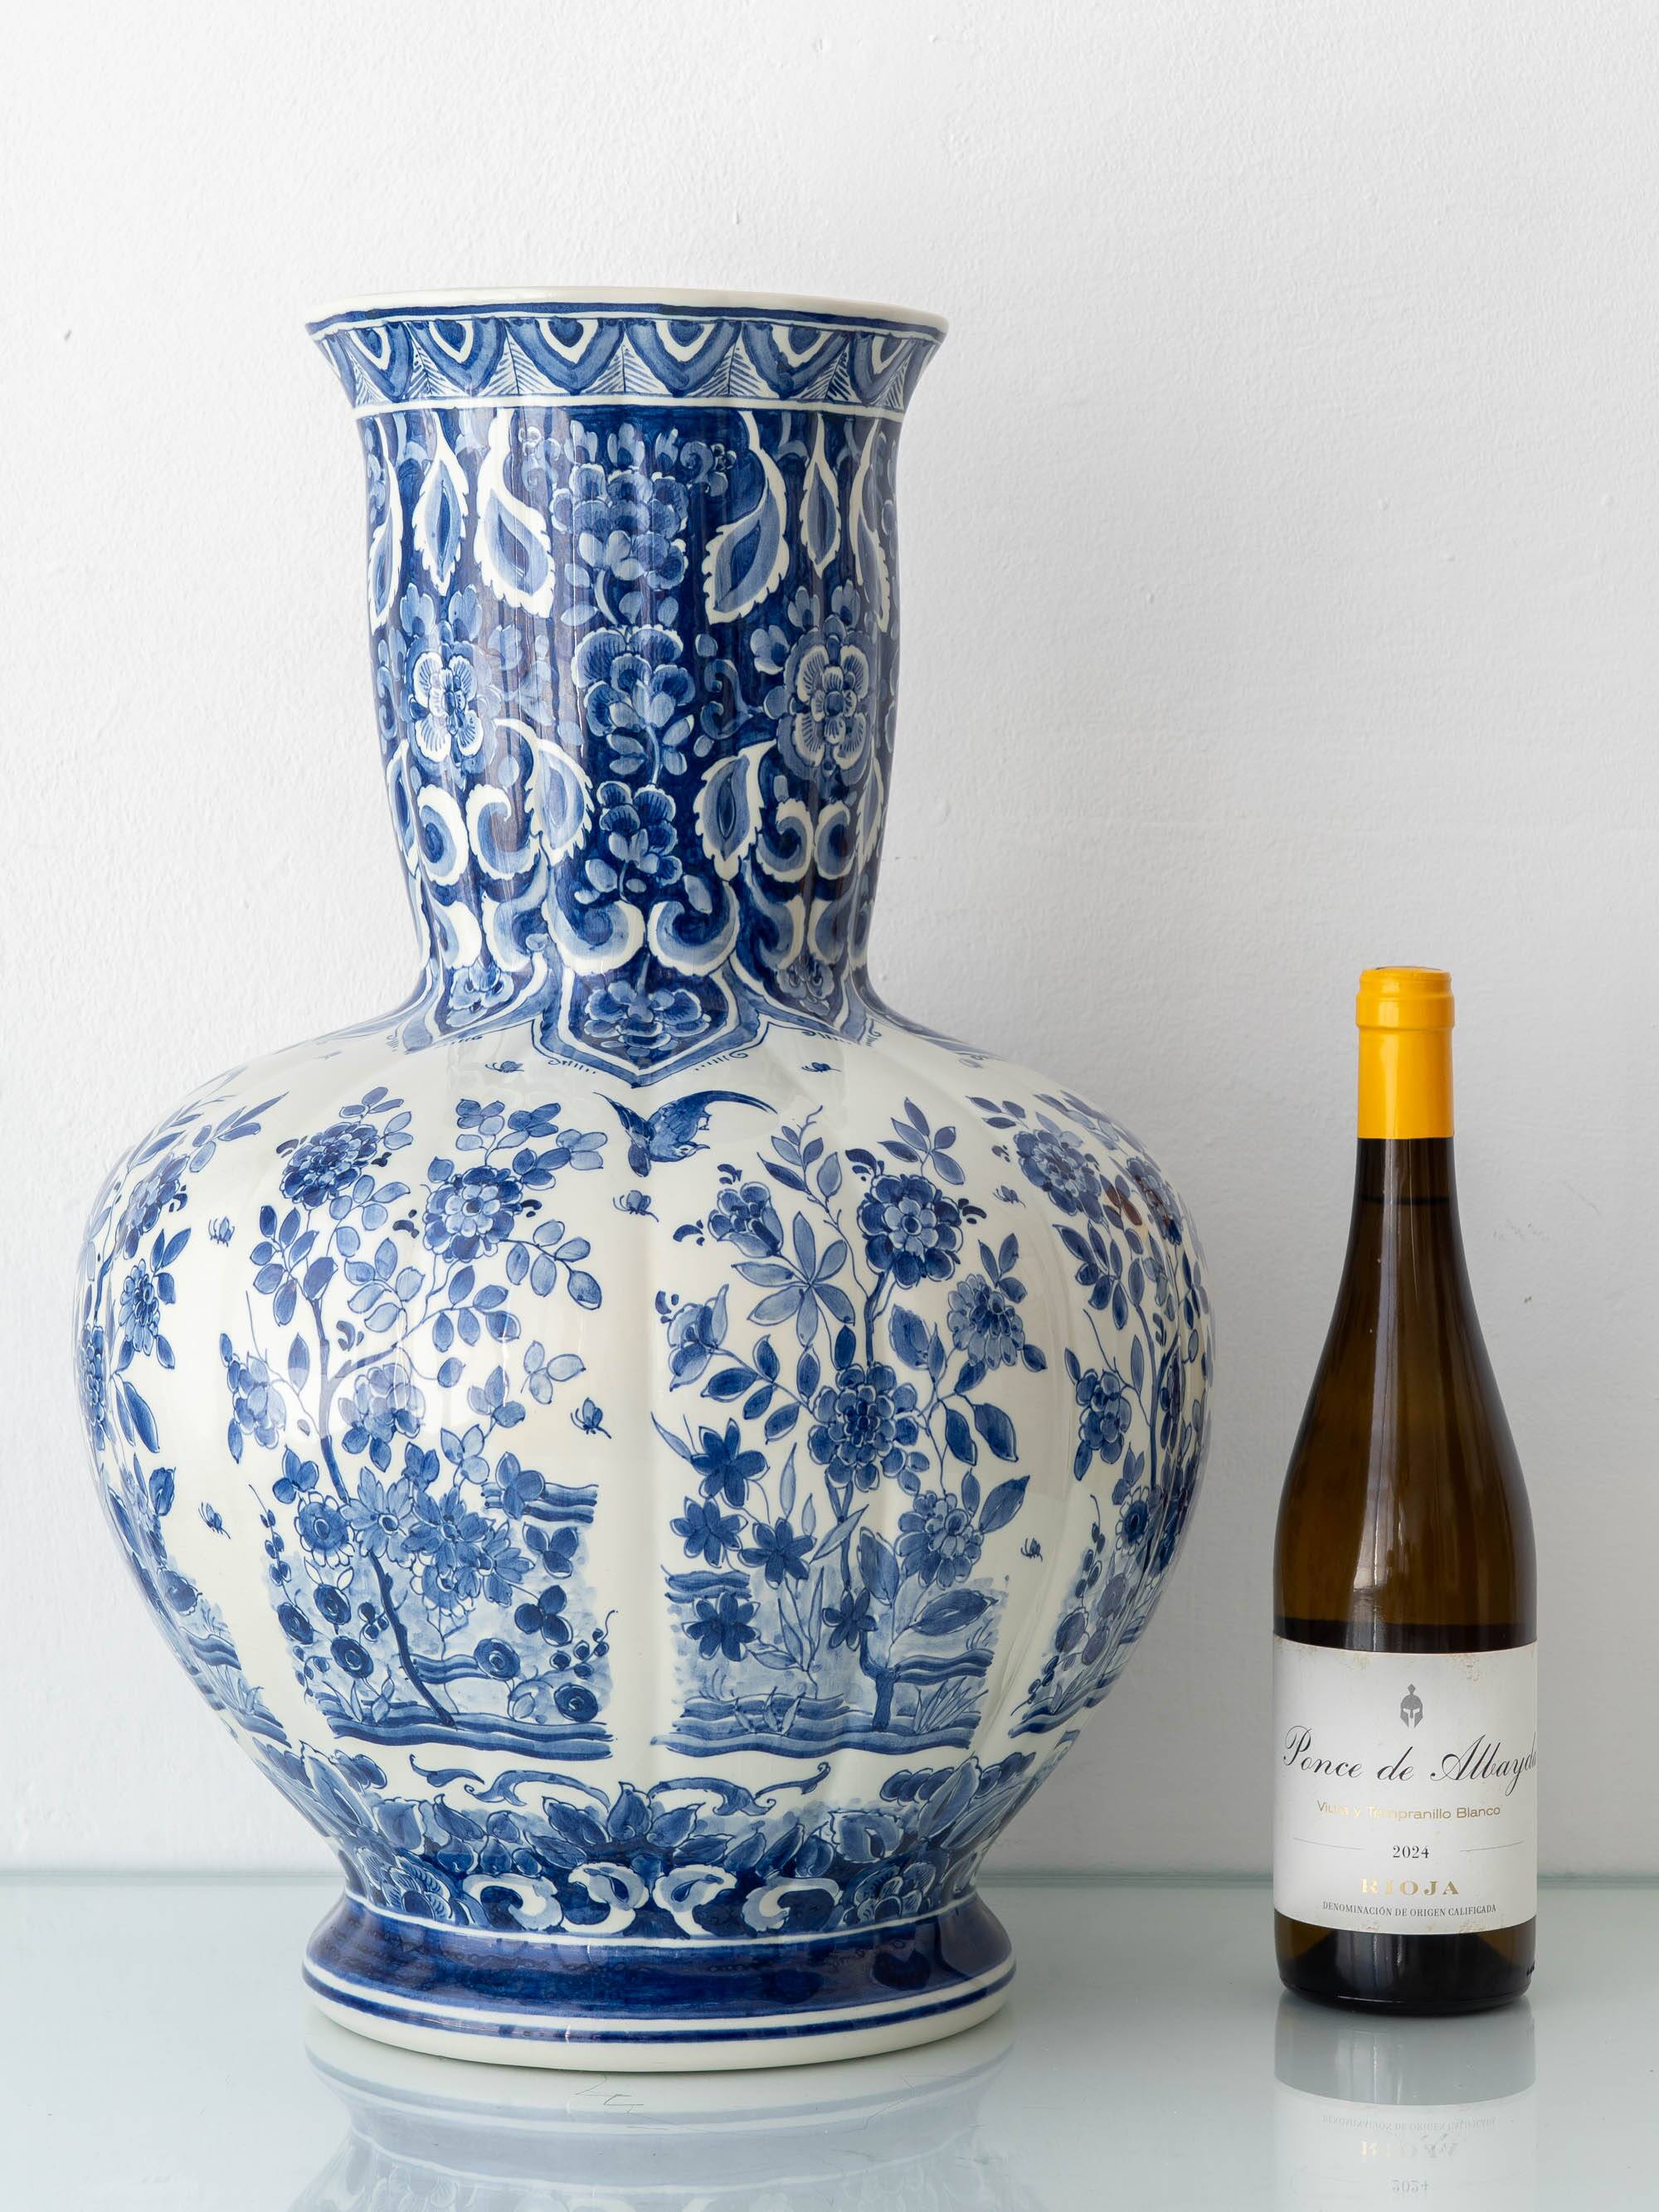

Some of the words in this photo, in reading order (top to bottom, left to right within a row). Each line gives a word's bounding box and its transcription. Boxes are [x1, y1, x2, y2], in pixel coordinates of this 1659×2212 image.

[1283, 1725, 1362, 1778] Ponce
[1377, 1746, 1414, 1781] de
[1353, 1806, 1361, 1819] y
[1367, 1806, 1452, 1822] Tempranillo
[1457, 1806, 1501, 1819] Blanco
[1392, 1845, 1430, 1859] 2024
[1360, 1878, 1459, 1896] RIOJA
[1322, 1901, 1393, 1916] DENOMINACIÓN
[1395, 1908, 1408, 1917] DE
[1410, 1907, 1446, 1918] ORIGEN
[1447, 1903, 1496, 1916] CALIFICADA
